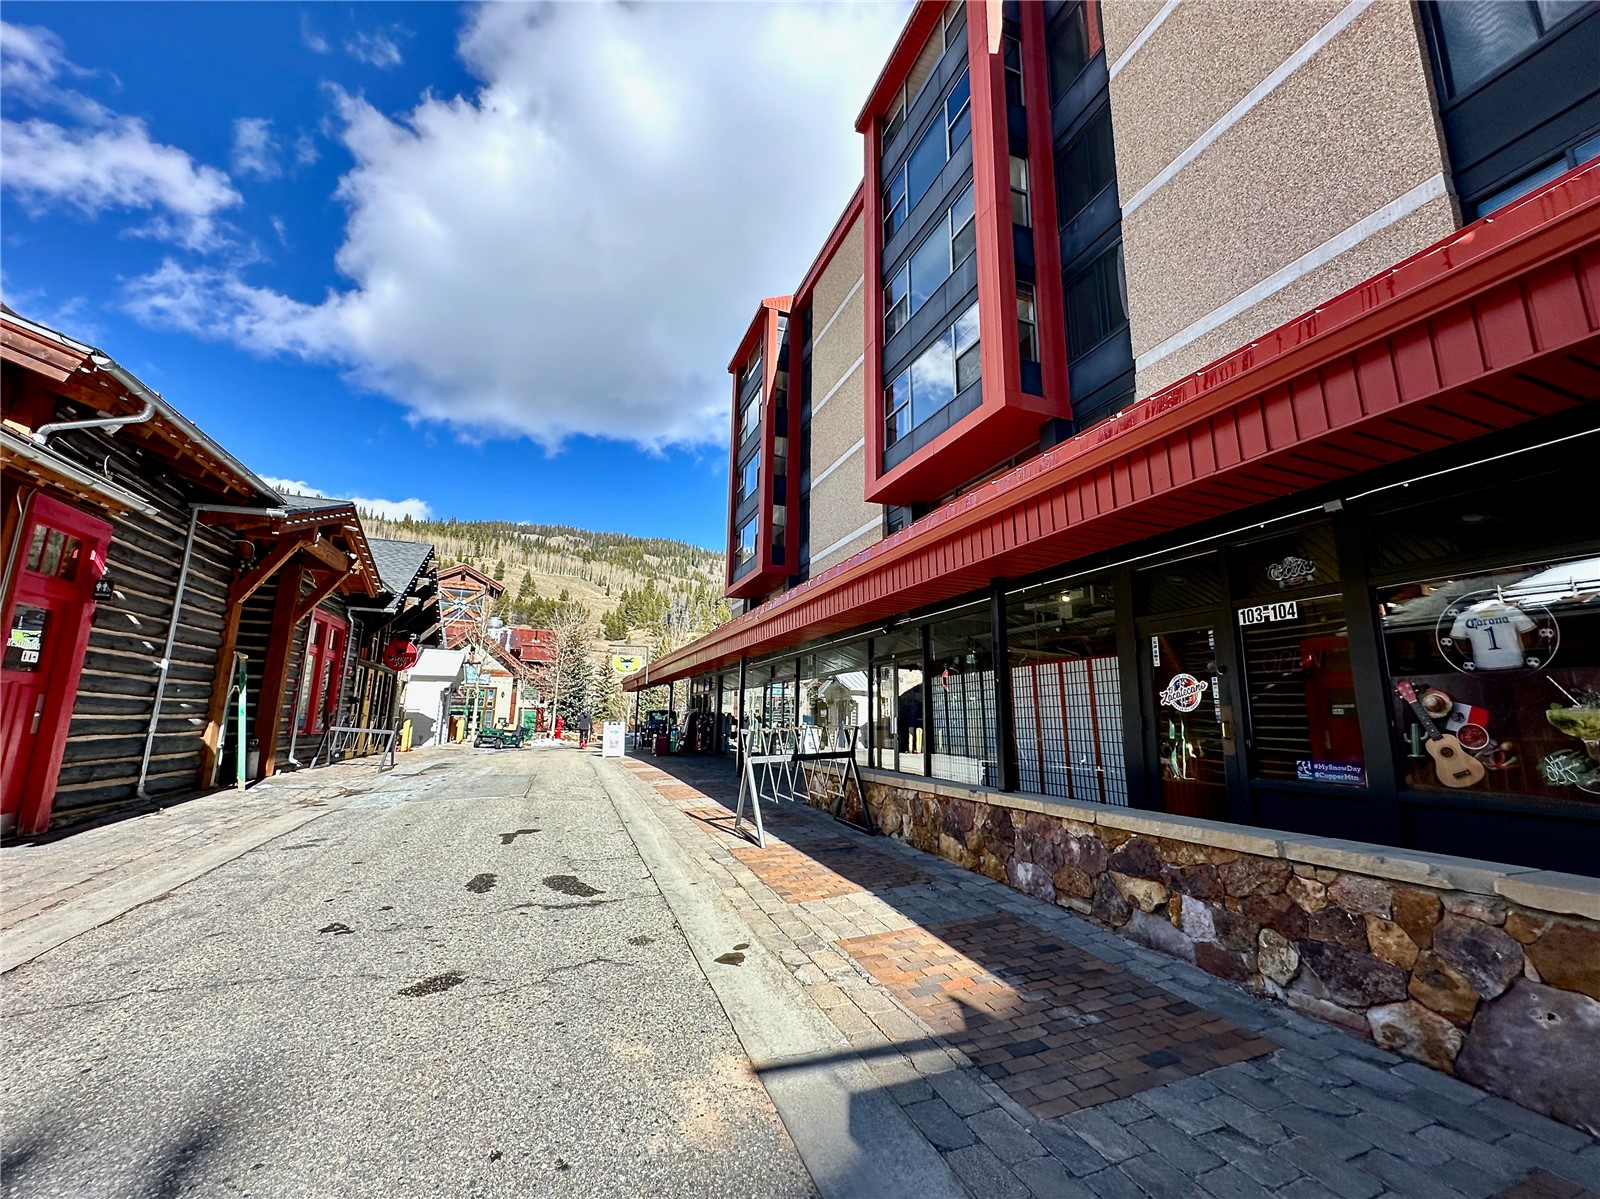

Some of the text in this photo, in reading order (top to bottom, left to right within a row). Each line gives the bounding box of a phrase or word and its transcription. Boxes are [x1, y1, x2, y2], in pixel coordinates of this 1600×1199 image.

[1465, 616, 1510, 629] Corona
[1483, 626, 1502, 651] 1
[1313, 763, 1362, 773] #MySnowDay
[1314, 772, 1360, 781] #CopperMtn
